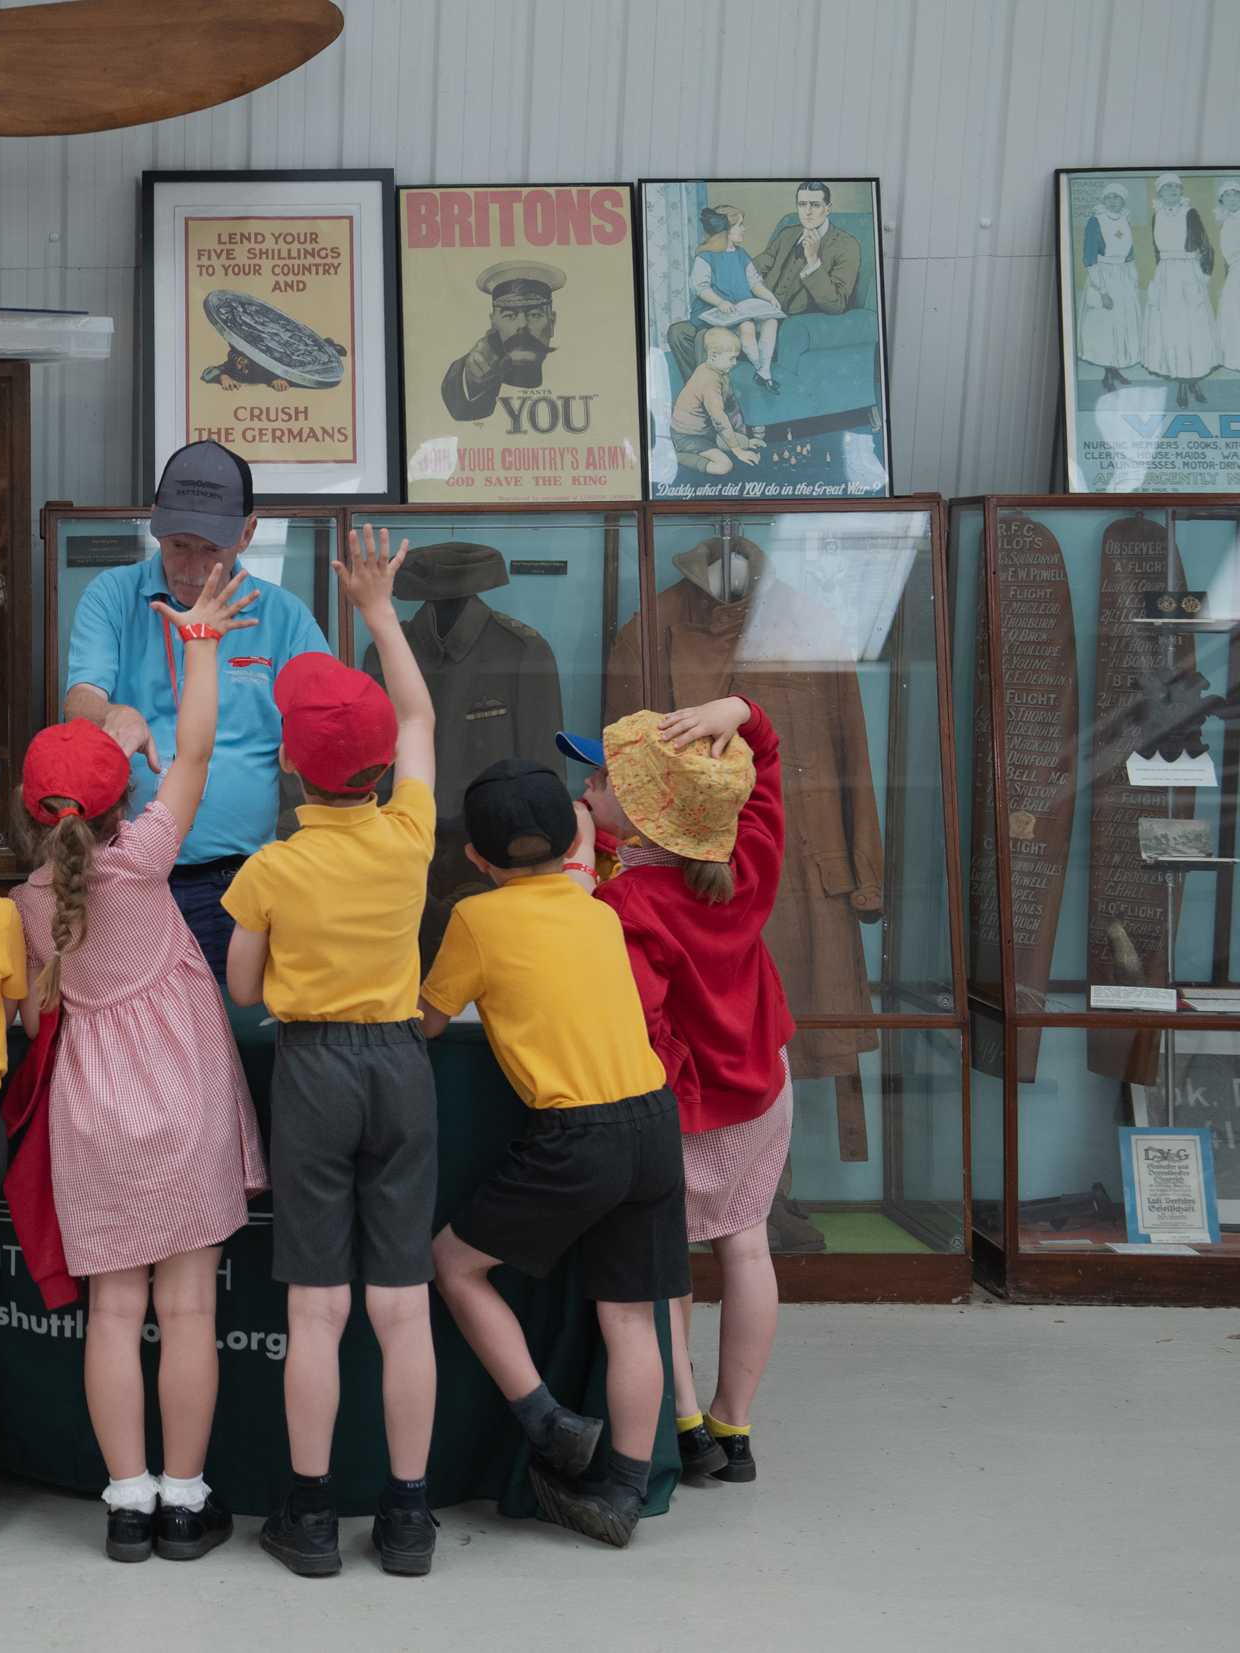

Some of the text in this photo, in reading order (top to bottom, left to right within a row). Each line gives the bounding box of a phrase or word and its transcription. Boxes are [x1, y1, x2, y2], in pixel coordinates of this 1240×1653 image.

[406, 189, 628, 249] BRITONS
[217, 231, 319, 246] LEND YOUR
[197, 247, 341, 261] FIVE SHILLINGS
[197, 262, 342, 277] TO YOUR COUNTRY
[271, 280, 307, 293] AND
[233, 406, 309, 423] CRUSH
[194, 426, 349, 443] THE GERMANS
[1083, 441, 1128, 450] NURSING
[1132, 441, 1179, 450] MEMBERS
[417, 444, 635, 473] JOIN YOUR COUNTRY'S ARMY!
[1084, 452, 1127, 460] CLERKS
[1137, 452, 1207, 460] HOUSE-MAIDS
[445, 475, 608, 487] GOD SAVE THE KING
[1093, 472, 1129, 485] ARE
[1136, 472, 1219, 485] URGENTLY
[656, 481, 695, 500] Daddy,
[696, 482, 720, 496] what
[722, 482, 742, 496] did
[743, 482, 764, 496] YOU
[764, 481, 779, 496] do
[781, 482, 793, 495] in
[795, 482, 814, 496] the
[814, 481, 843, 496] Great
[847, 481, 869, 495] War
